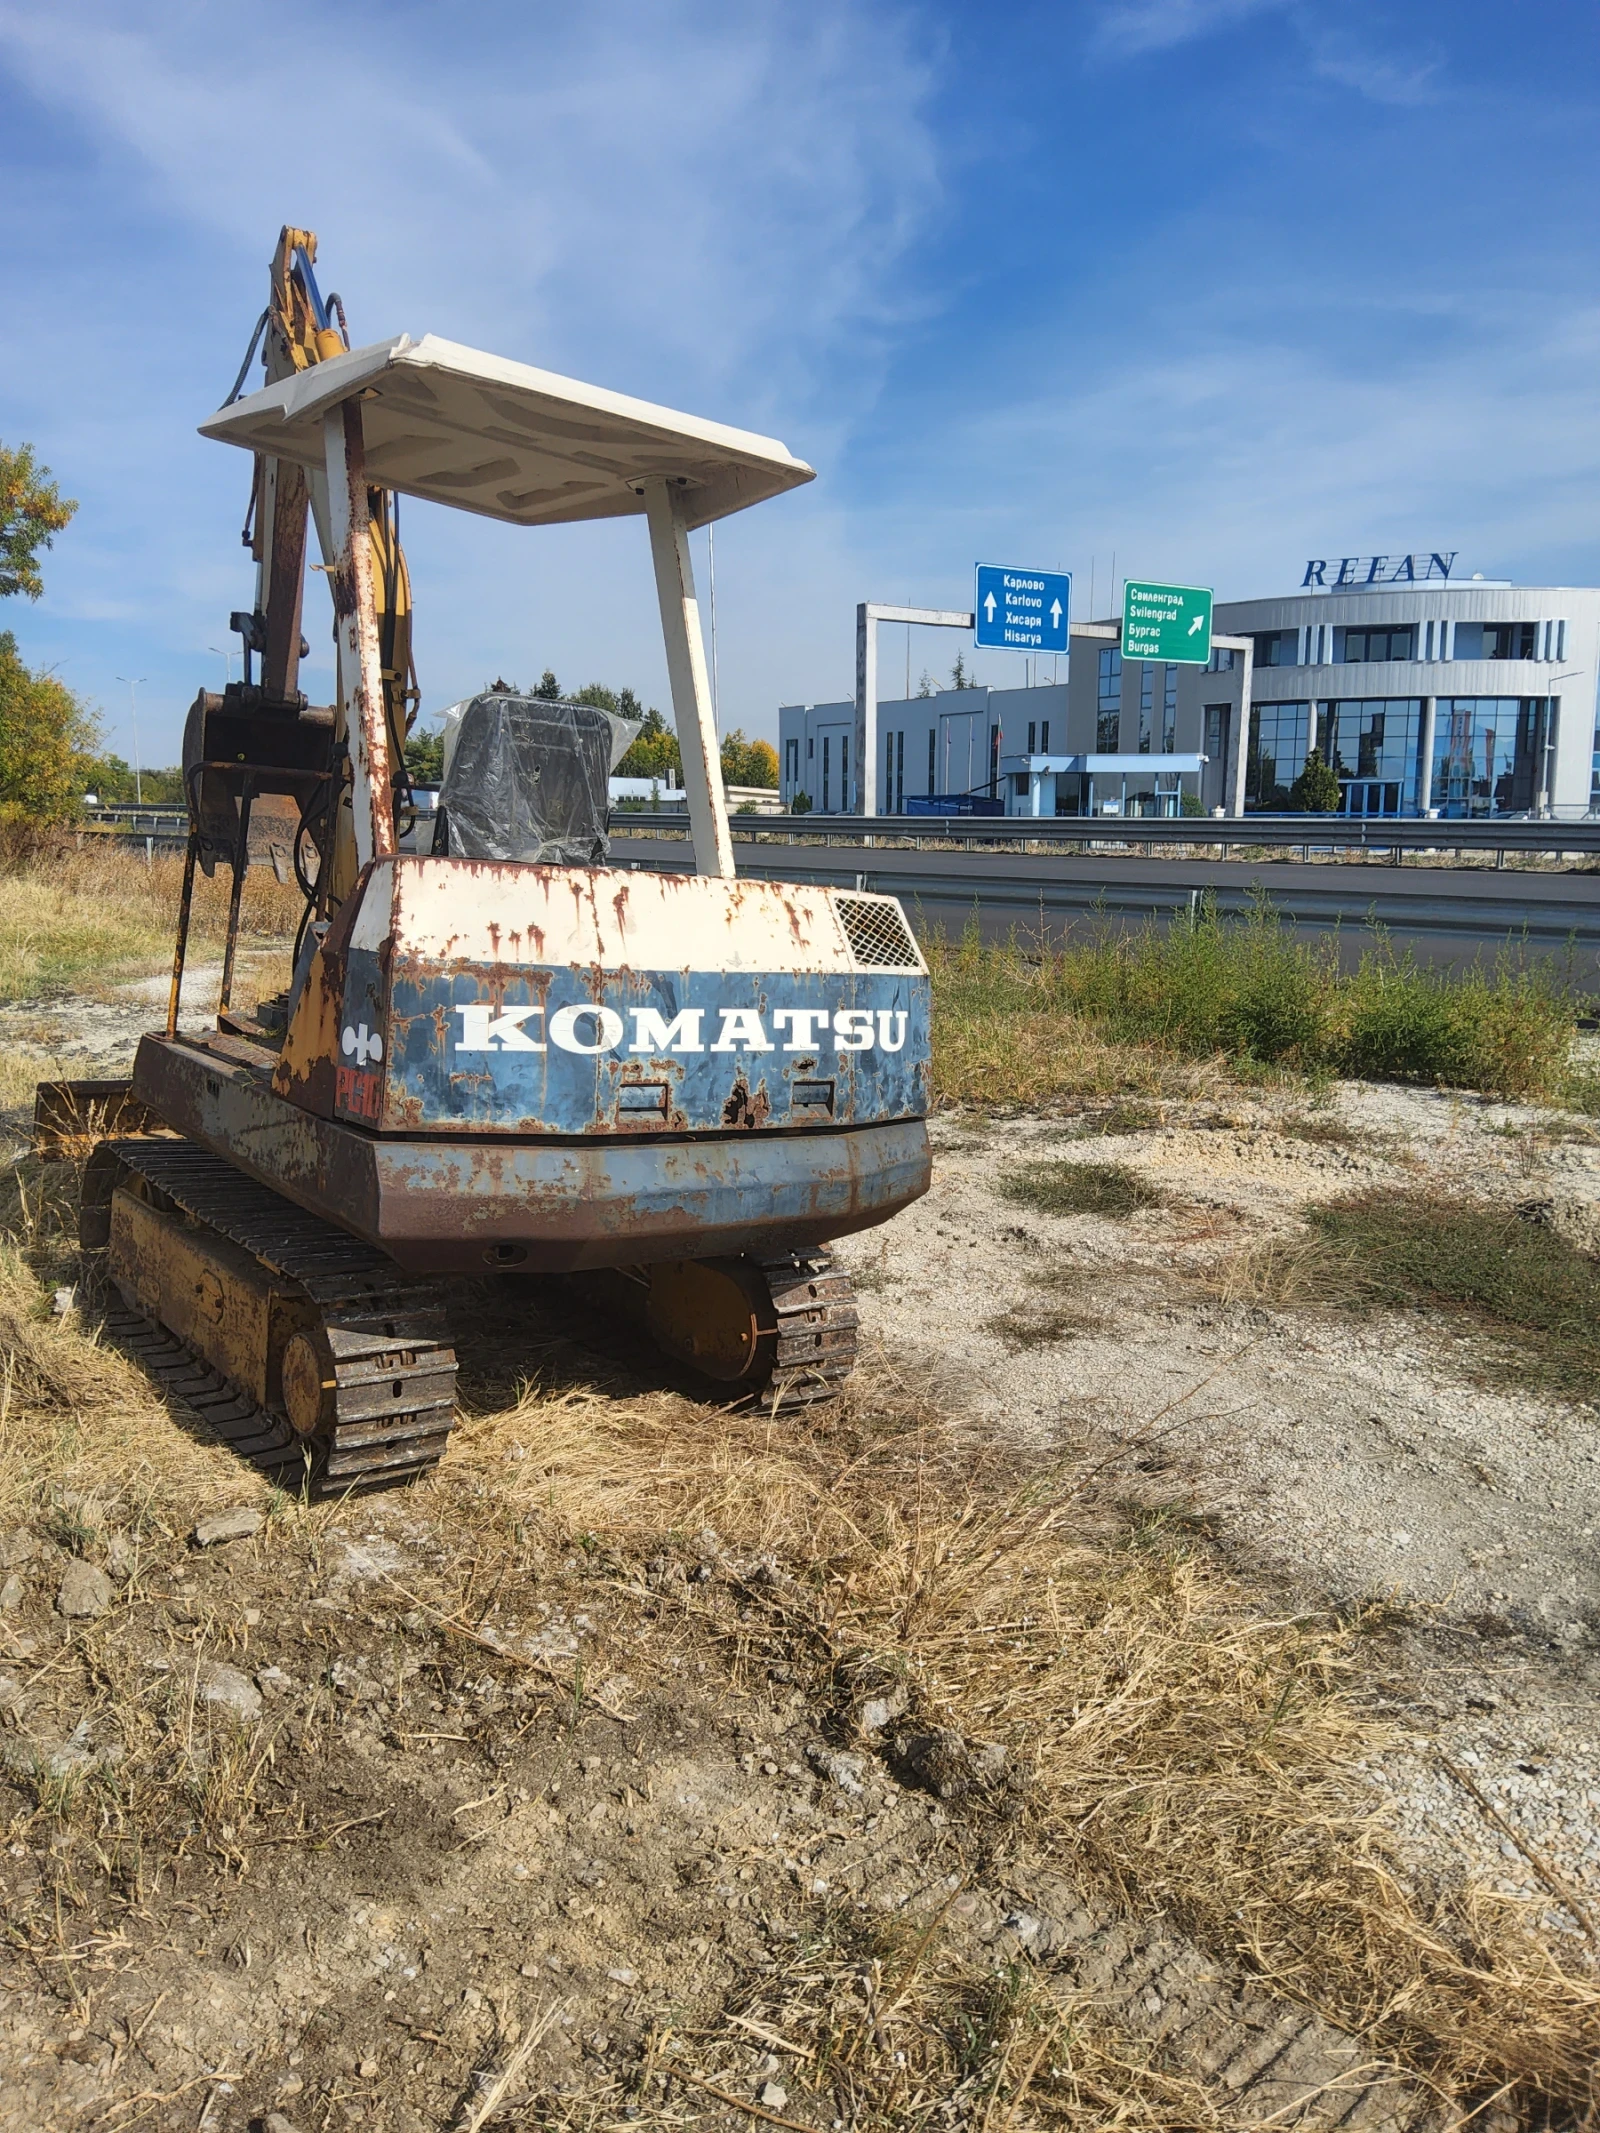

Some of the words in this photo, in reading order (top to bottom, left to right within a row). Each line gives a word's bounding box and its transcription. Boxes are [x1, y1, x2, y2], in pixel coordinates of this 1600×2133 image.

[1300, 552, 1459, 586] REFAN
[1003, 574, 1045, 591] Карлово
[1005, 592, 1042, 608] Karlovo
[1130, 588, 1184, 606] Свиленград
[1005, 611, 1042, 629] Хисаря
[1129, 605, 1177, 622] Svilengrad
[1004, 629, 1042, 646] Hisarya
[1128, 623, 1161, 638] Бургас
[1127, 640, 1160, 655] Burgas
[454, 1003, 909, 1055] KOMATSU
